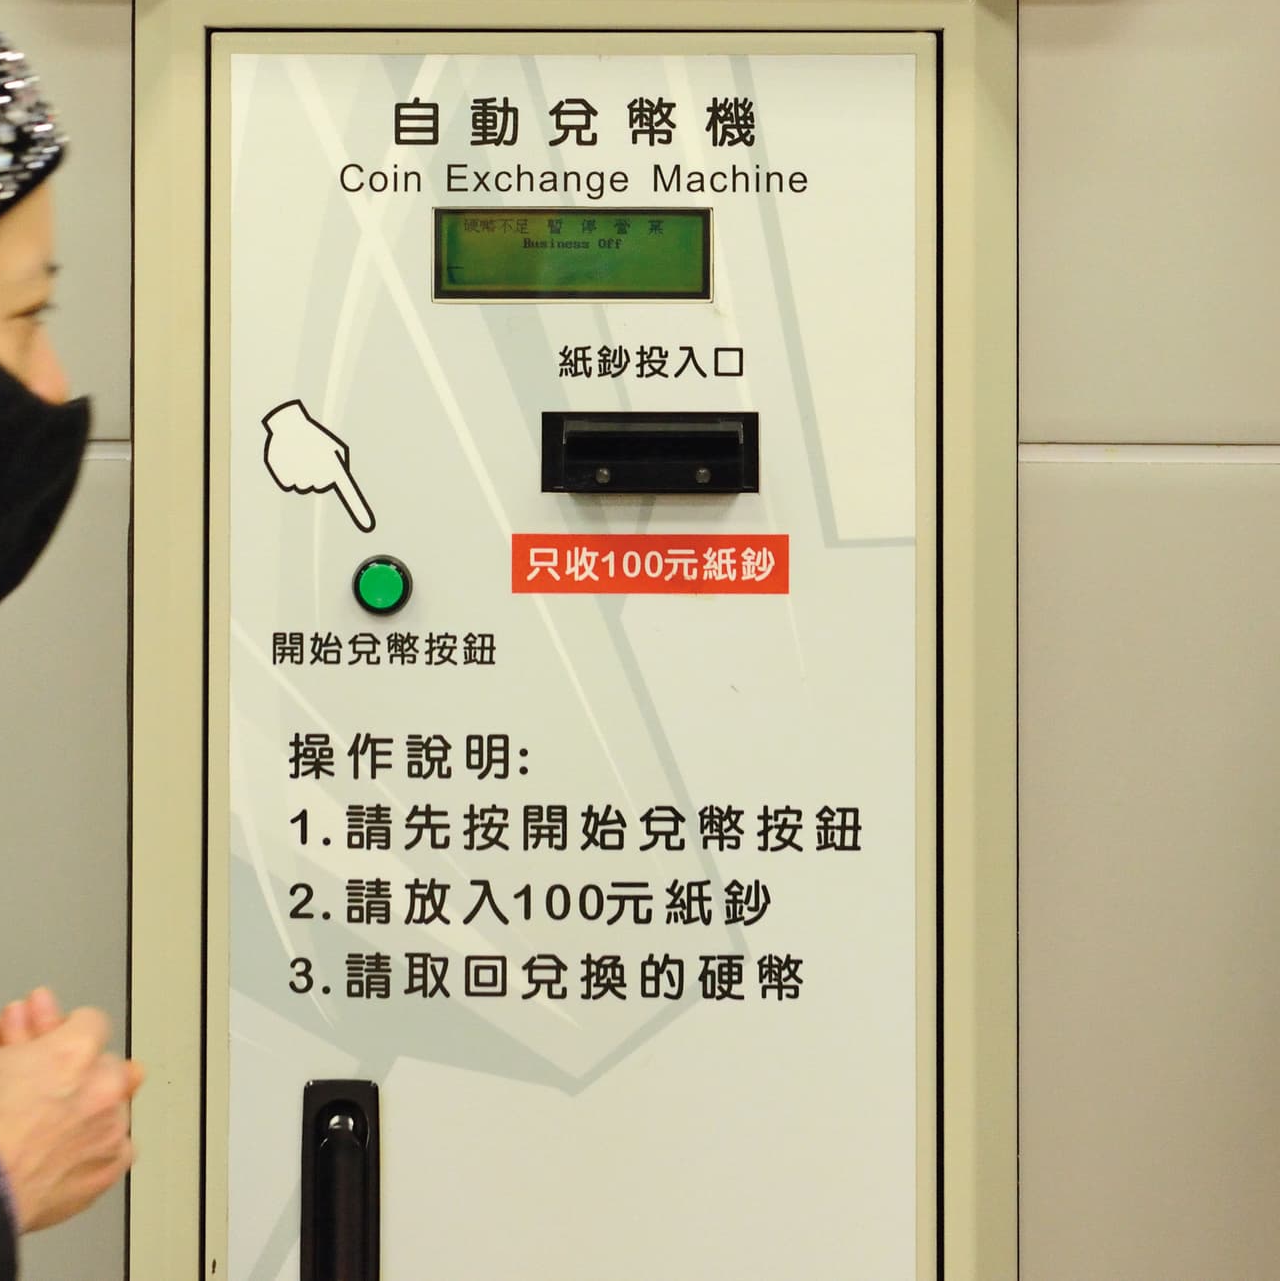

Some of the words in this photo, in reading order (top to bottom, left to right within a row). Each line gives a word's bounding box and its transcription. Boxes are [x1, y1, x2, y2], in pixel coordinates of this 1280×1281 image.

[394, 97, 756, 147] 自動兌幣機
[339, 163, 422, 193] Coin
[447, 163, 629, 200] Exchange
[652, 163, 808, 193] Machine
[523, 238, 589, 249] Business
[598, 238, 623, 249] Off
[558, 345, 745, 379] 紙鈔投入口
[526, 546, 776, 583] 只收100元紙鈔
[272, 632, 497, 667] 開始兌幣按鈕
